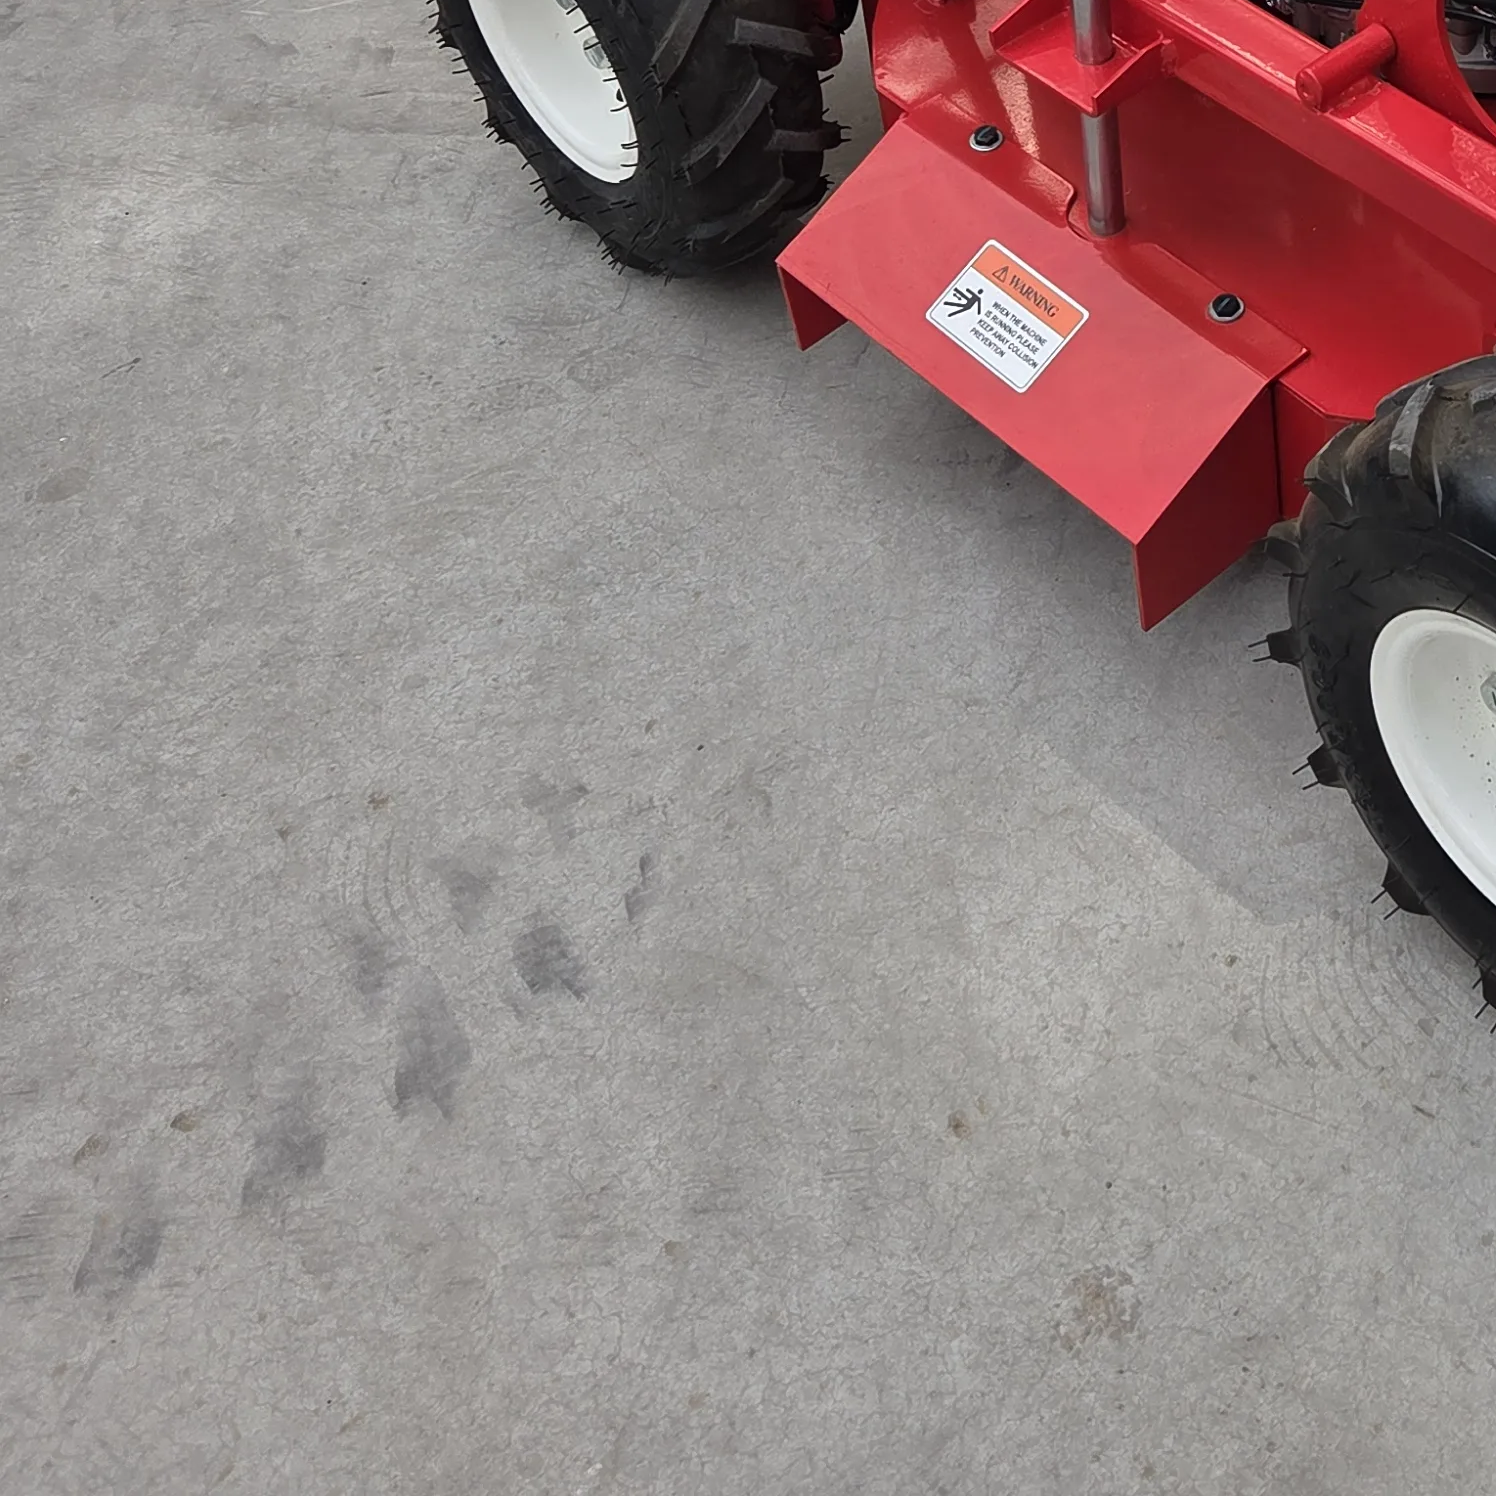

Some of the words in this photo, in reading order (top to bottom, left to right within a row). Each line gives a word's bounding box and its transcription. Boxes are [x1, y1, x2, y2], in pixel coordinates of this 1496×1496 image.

[1009, 274, 1059, 317] WARNING
[970, 328, 1006, 358] PREVENTION
[977, 319, 994, 332] KEEP
[992, 331, 1009, 345] AWAY
[1008, 343, 1039, 369] COLLISION
[984, 310, 992, 318] IS
[990, 315, 1017, 337] RUNNING
[1016, 334, 1039, 355] PLEASE
[992, 302, 1011, 318] WHEN
[1009, 314, 1023, 327] THE
[1020, 324, 1047, 346] MACHINE
